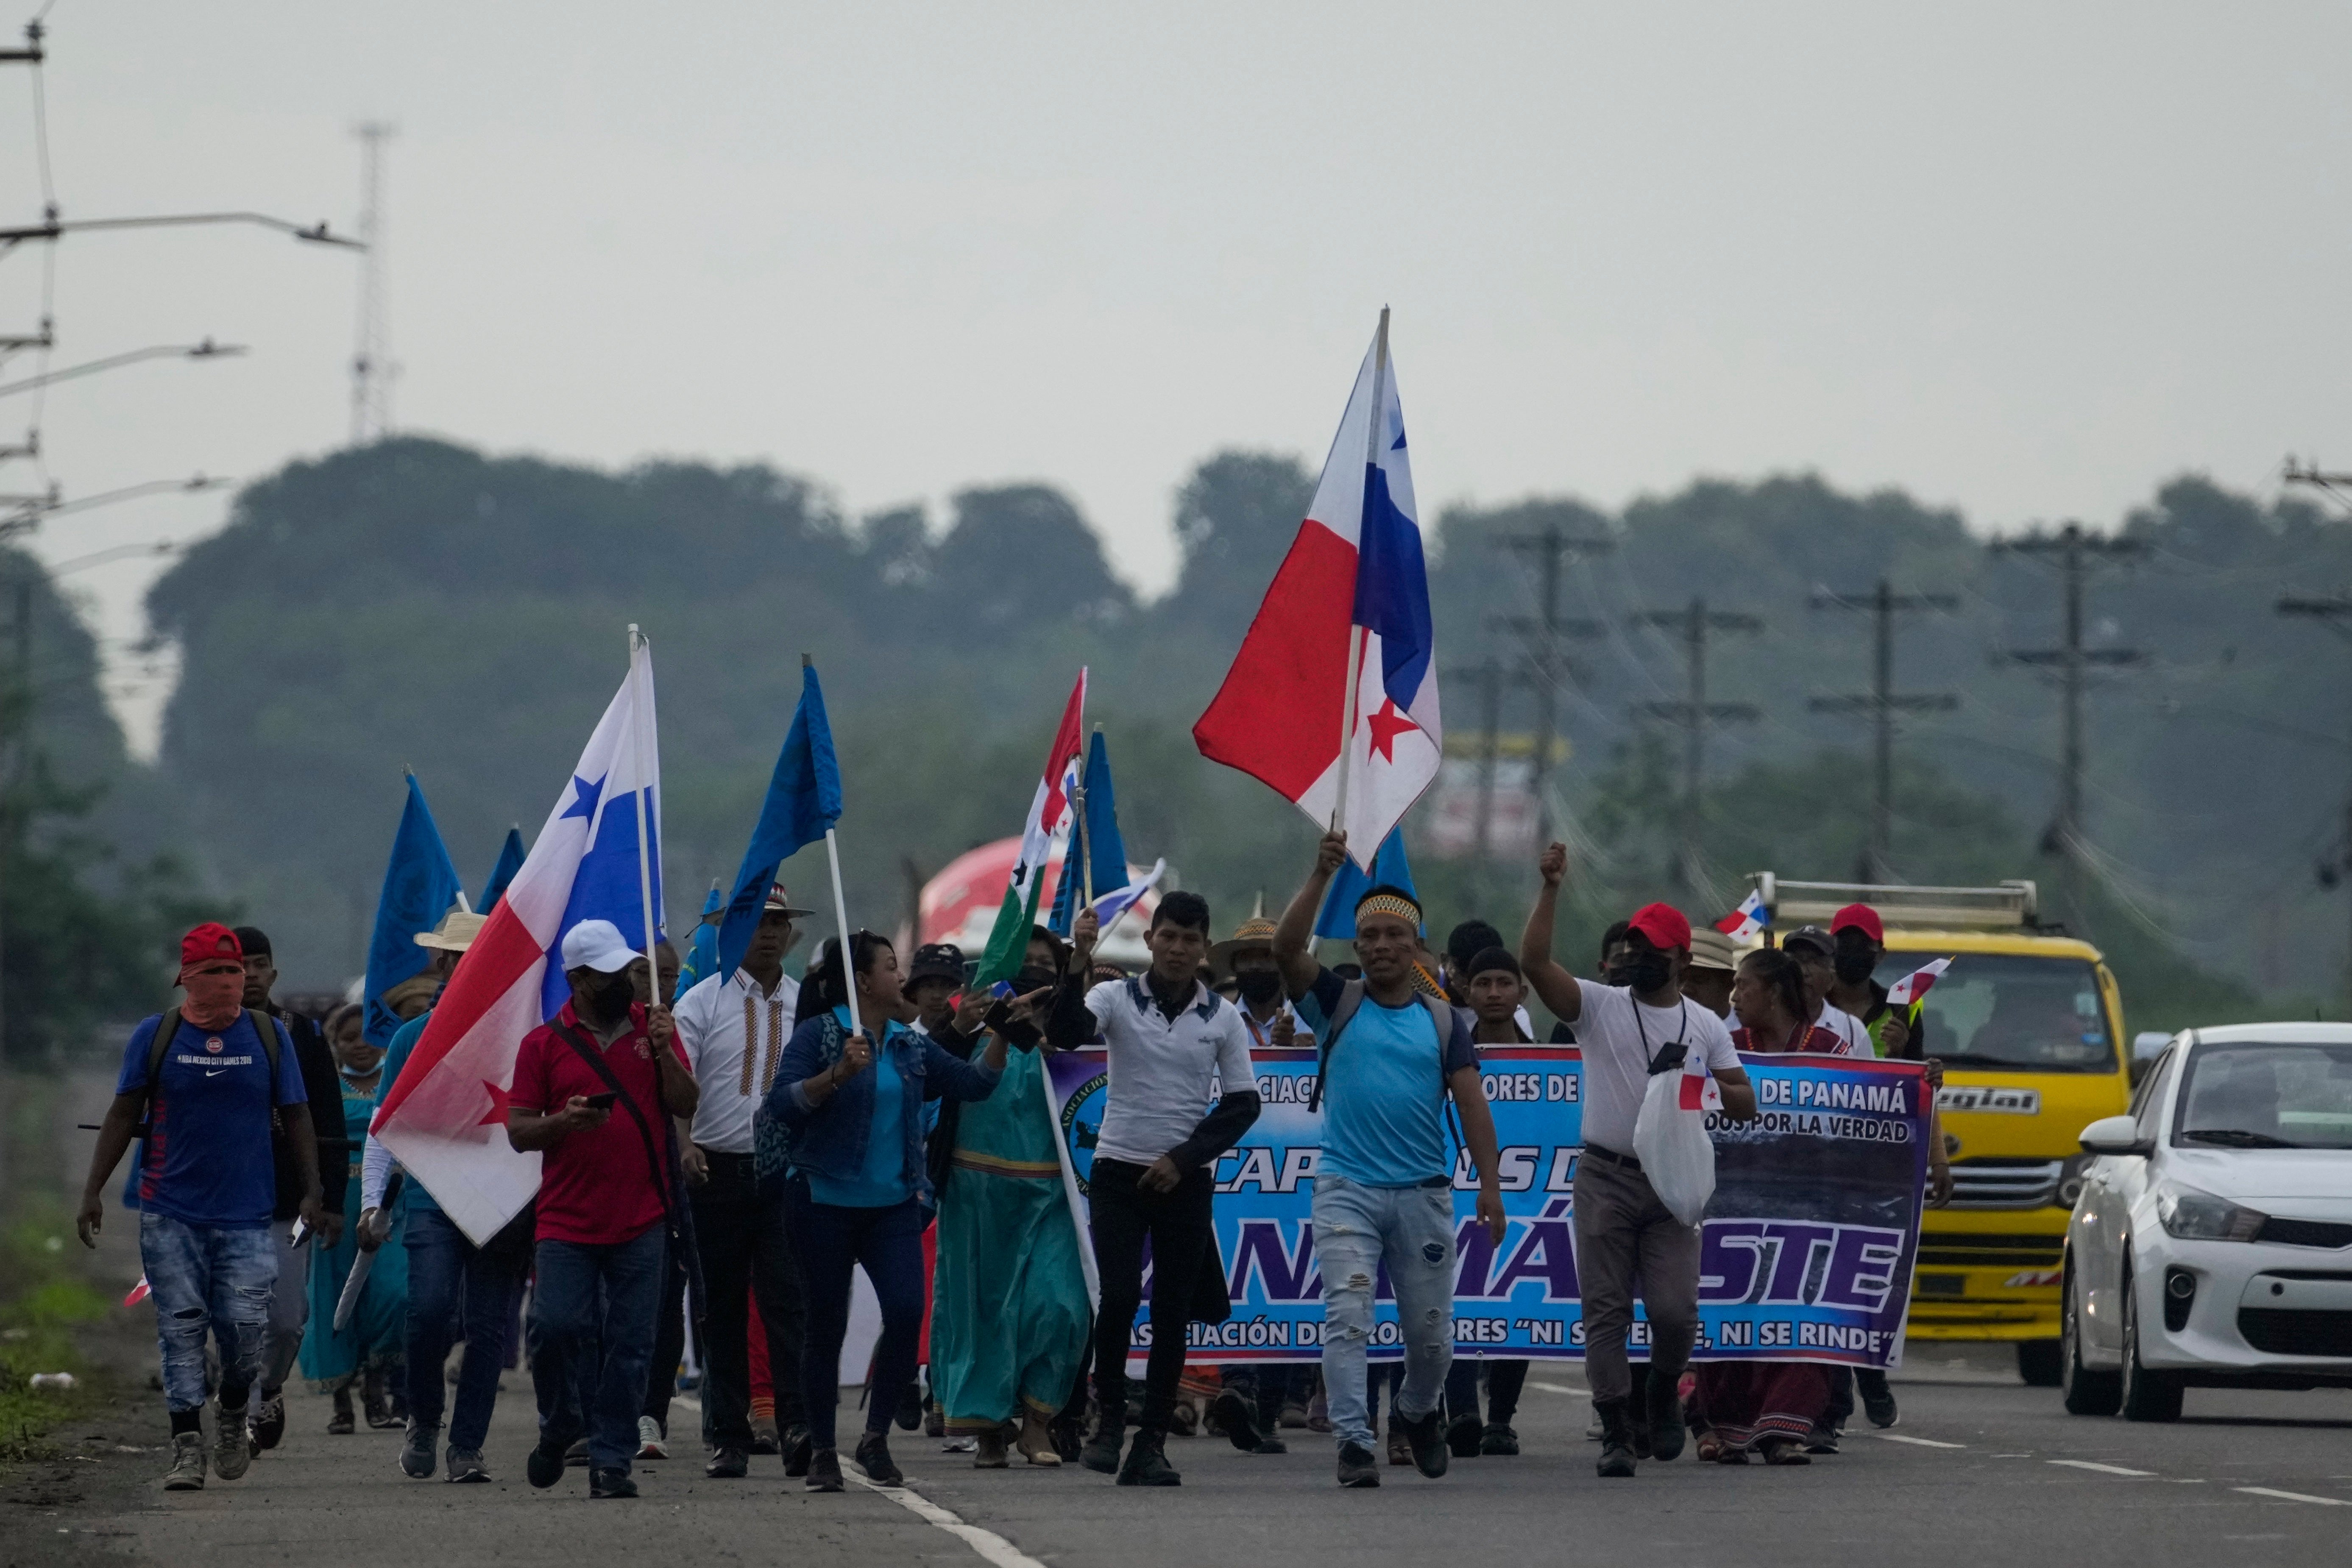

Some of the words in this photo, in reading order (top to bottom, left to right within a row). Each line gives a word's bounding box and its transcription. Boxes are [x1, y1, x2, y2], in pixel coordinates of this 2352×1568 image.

[192, 1055, 211, 1065] MEXICO
[211, 1056, 223, 1065] CITY
[223, 1056, 240, 1066] GAMES
[240, 1055, 252, 1065] 2019
[1547, 1074, 1579, 1102] DE
[1761, 1078, 1792, 1105] DE
[1798, 1080, 1907, 1114] PANAMÁ
[1751, 1112, 1792, 1133] POR
[1797, 1114, 1822, 1135] LA
[1828, 1116, 1909, 1143] VERDAD
[1721, 1321, 1753, 1346] NI
[1759, 1321, 1792, 1346] SE
